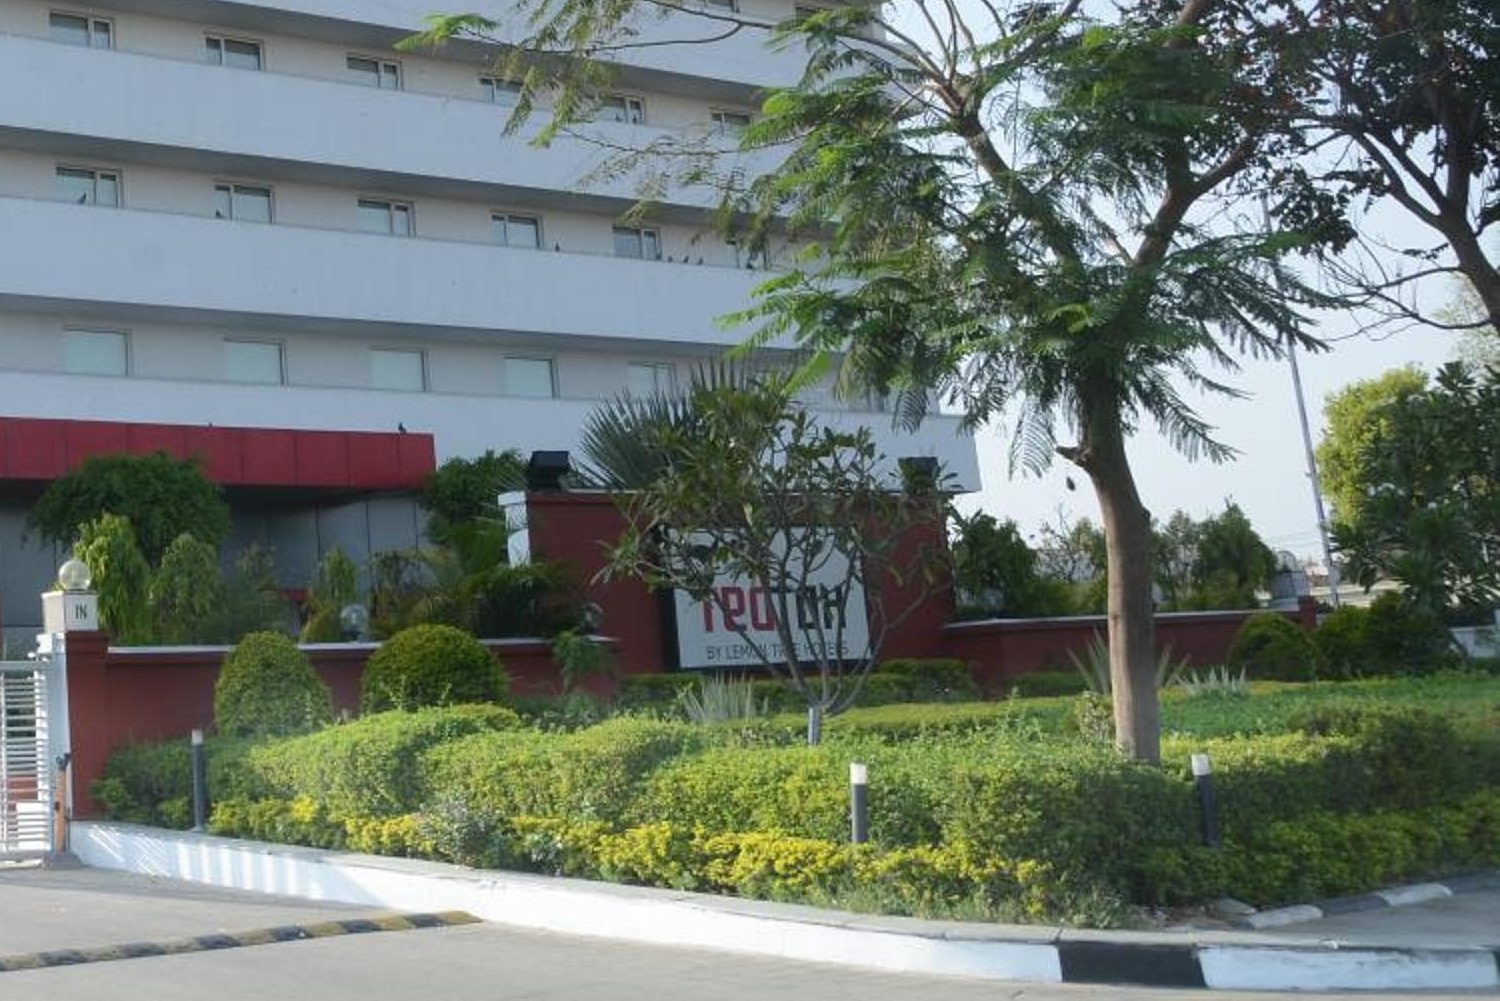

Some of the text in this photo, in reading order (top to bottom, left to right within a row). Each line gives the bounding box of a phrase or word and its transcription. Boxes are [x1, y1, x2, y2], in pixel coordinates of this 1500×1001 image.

[75, 603, 87, 620] IN
[701, 576, 847, 632] redox
[707, 645, 722, 661] BY
